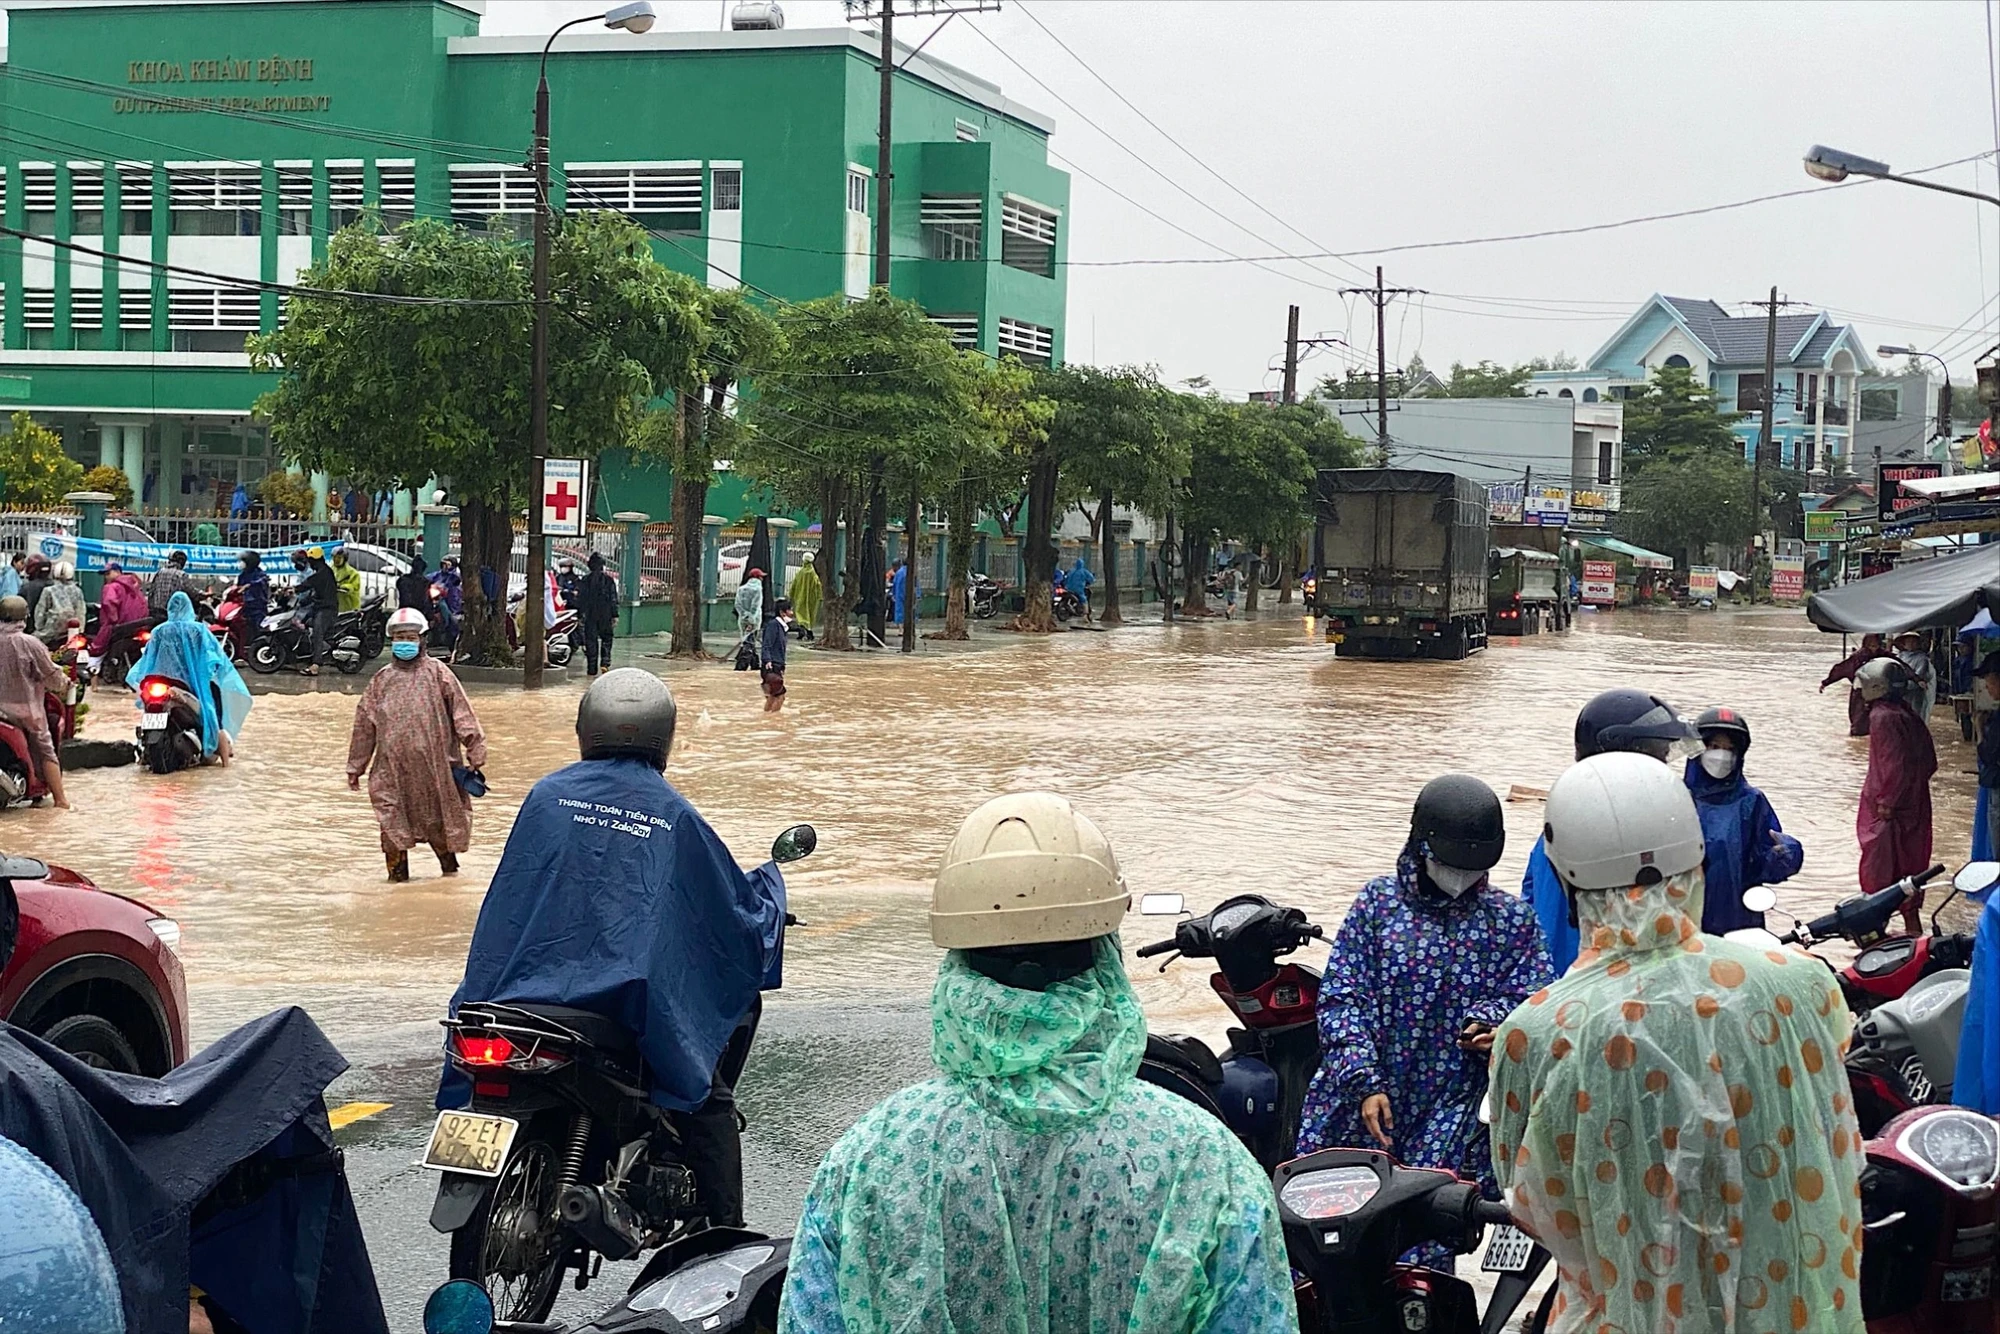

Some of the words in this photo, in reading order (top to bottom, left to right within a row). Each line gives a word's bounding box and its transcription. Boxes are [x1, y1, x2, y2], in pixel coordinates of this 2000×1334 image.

[128, 60, 185, 84] KHOA
[190, 55, 252, 83] KHÁM
[257, 53, 314, 87] BỆNH
[220, 96, 332, 112] DEPARTMENT
[1585, 564, 1613, 573] ENEOS
[558, 798, 592, 811] THANH
[594, 803, 622, 816] TOÁN
[625, 809, 648, 823] TIỀN
[650, 816, 673, 832] ĐIỆN
[611, 819, 652, 838] ZaloPay
[446, 1116, 502, 1145] 92-E1
[1485, 1242, 1529, 1268] 696.69
